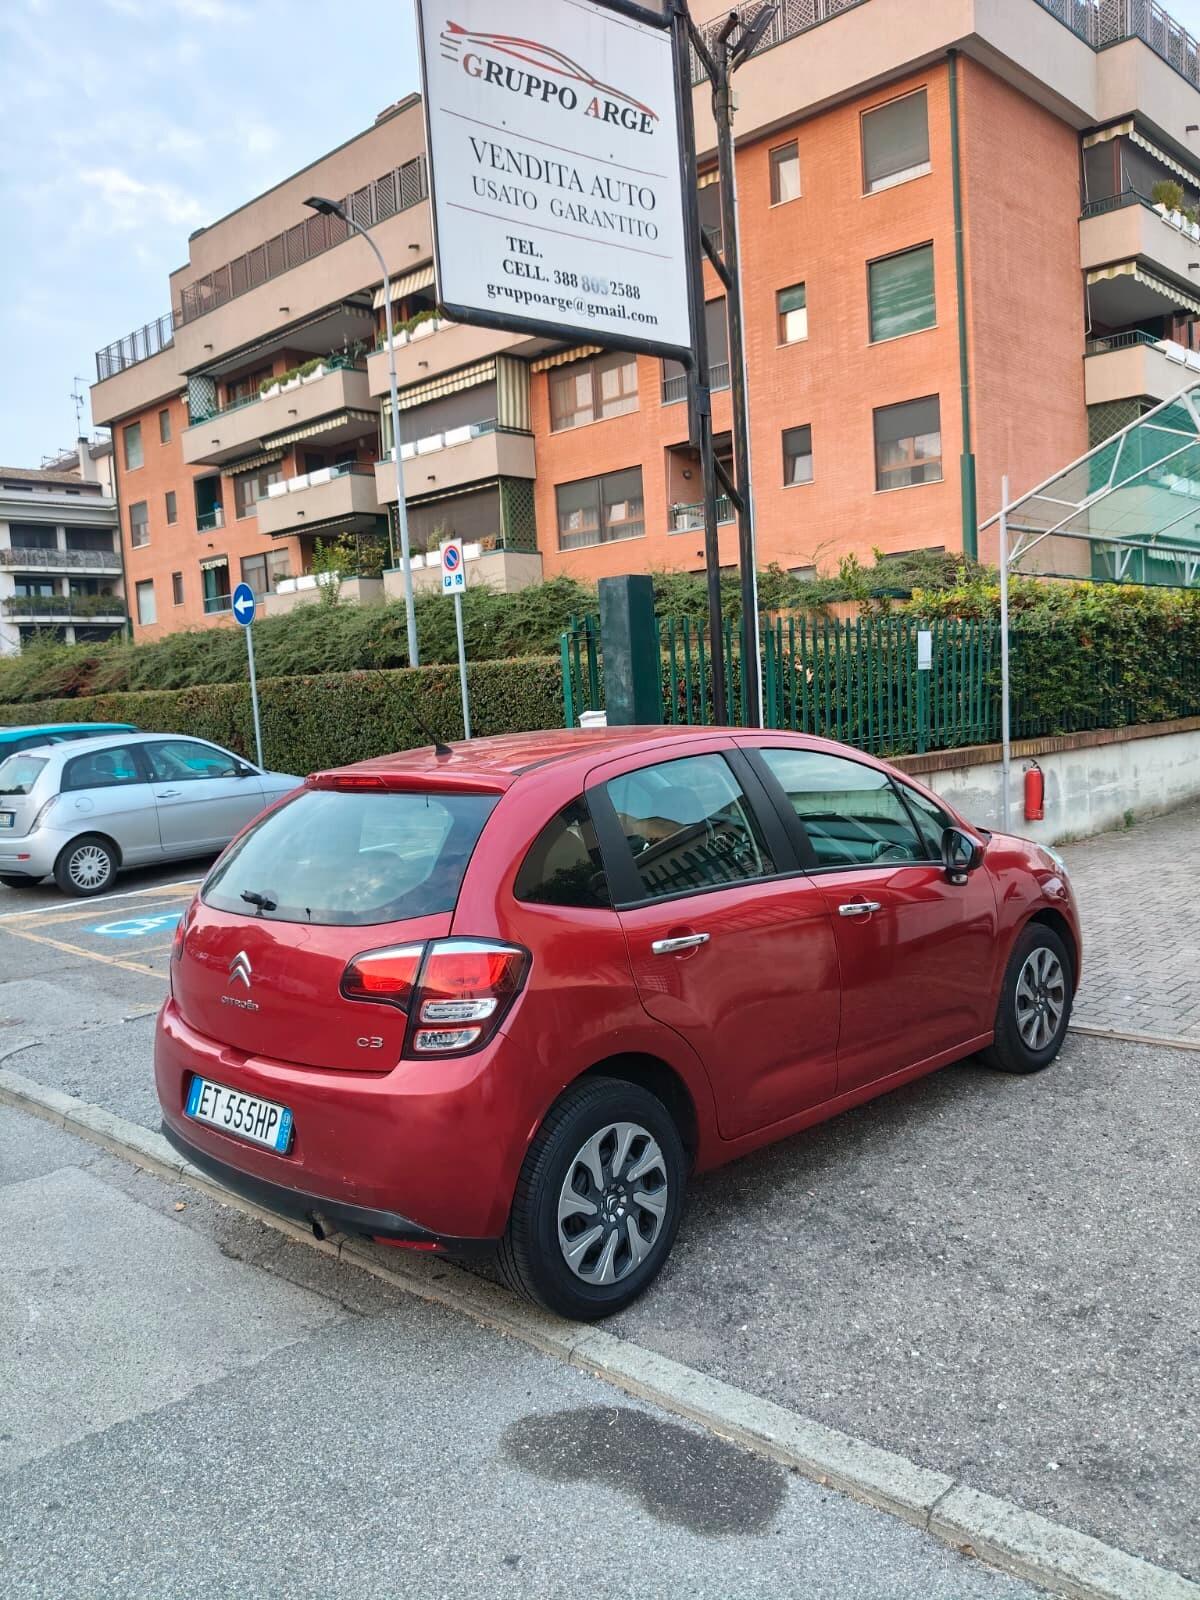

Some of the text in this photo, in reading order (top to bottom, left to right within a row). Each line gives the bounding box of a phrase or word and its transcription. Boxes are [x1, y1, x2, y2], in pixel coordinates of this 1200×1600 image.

[463, 53, 654, 134] GRUPPO ARGE
[468, 136, 656, 211] VENDITA AUTO
[472, 175, 658, 240] USATO GARANTITO
[506, 235, 543, 258] TEL.
[502, 258, 549, 282] CELL.
[553, 270, 578, 288] 388
[486, 283, 658, 325] gruppoarge@gmail.com
[356, 1036, 384, 1048] C3
[198, 1085, 221, 1117] ET
[223, 1094, 278, 1140] 555HP
